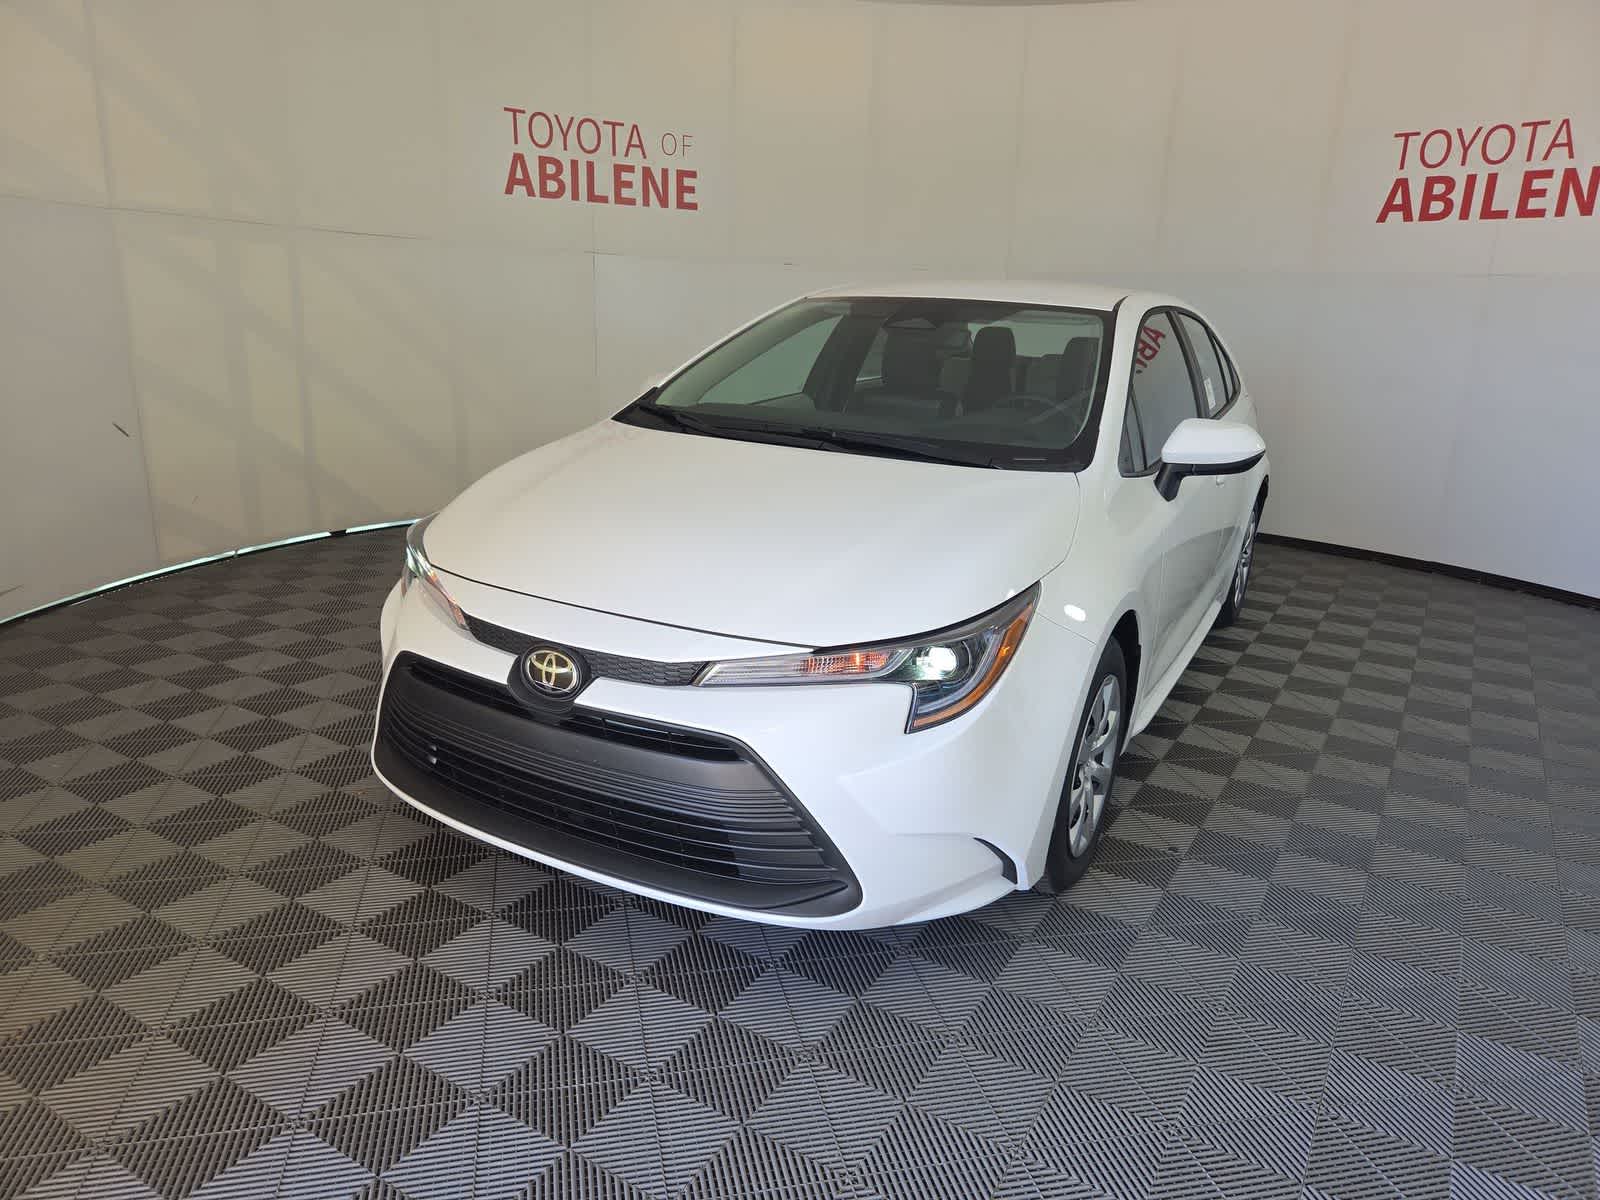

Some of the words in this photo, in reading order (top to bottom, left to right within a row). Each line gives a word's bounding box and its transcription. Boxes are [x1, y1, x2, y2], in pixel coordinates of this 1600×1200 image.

[503, 106, 647, 159] TOYOTA
[661, 132, 693, 157] OF
[1393, 118, 1575, 170] TOYOTA
[504, 152, 698, 211] ABILENE
[1375, 165, 1600, 223] ABILEN
